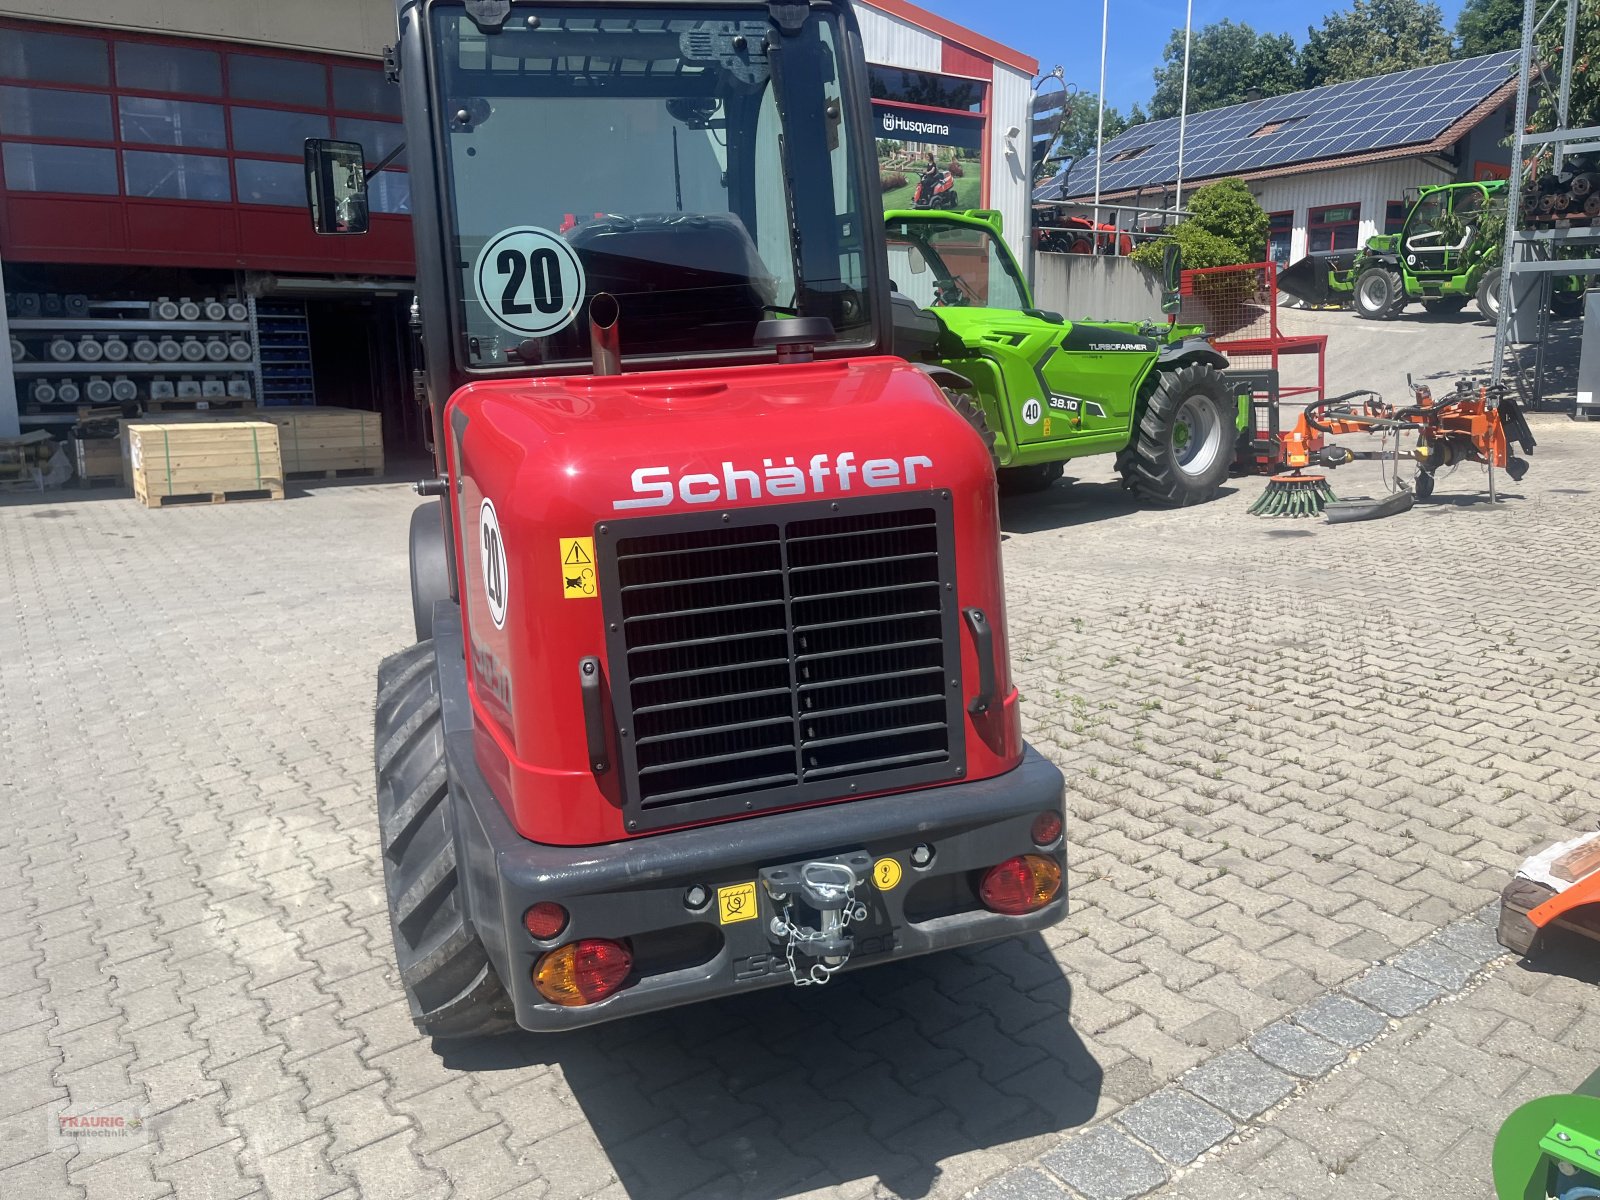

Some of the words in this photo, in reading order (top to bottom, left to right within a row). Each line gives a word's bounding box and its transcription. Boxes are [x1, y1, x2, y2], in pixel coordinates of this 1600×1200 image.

[895, 116, 949, 136] Husqvarna
[496, 247, 564, 316] 20
[1088, 343, 1148, 351] TURBOFARMER
[1025, 403, 1038, 420] 40
[1049, 397, 1078, 411] 38.10
[613, 452, 933, 511] Schäffer
[484, 522, 503, 609] 20
